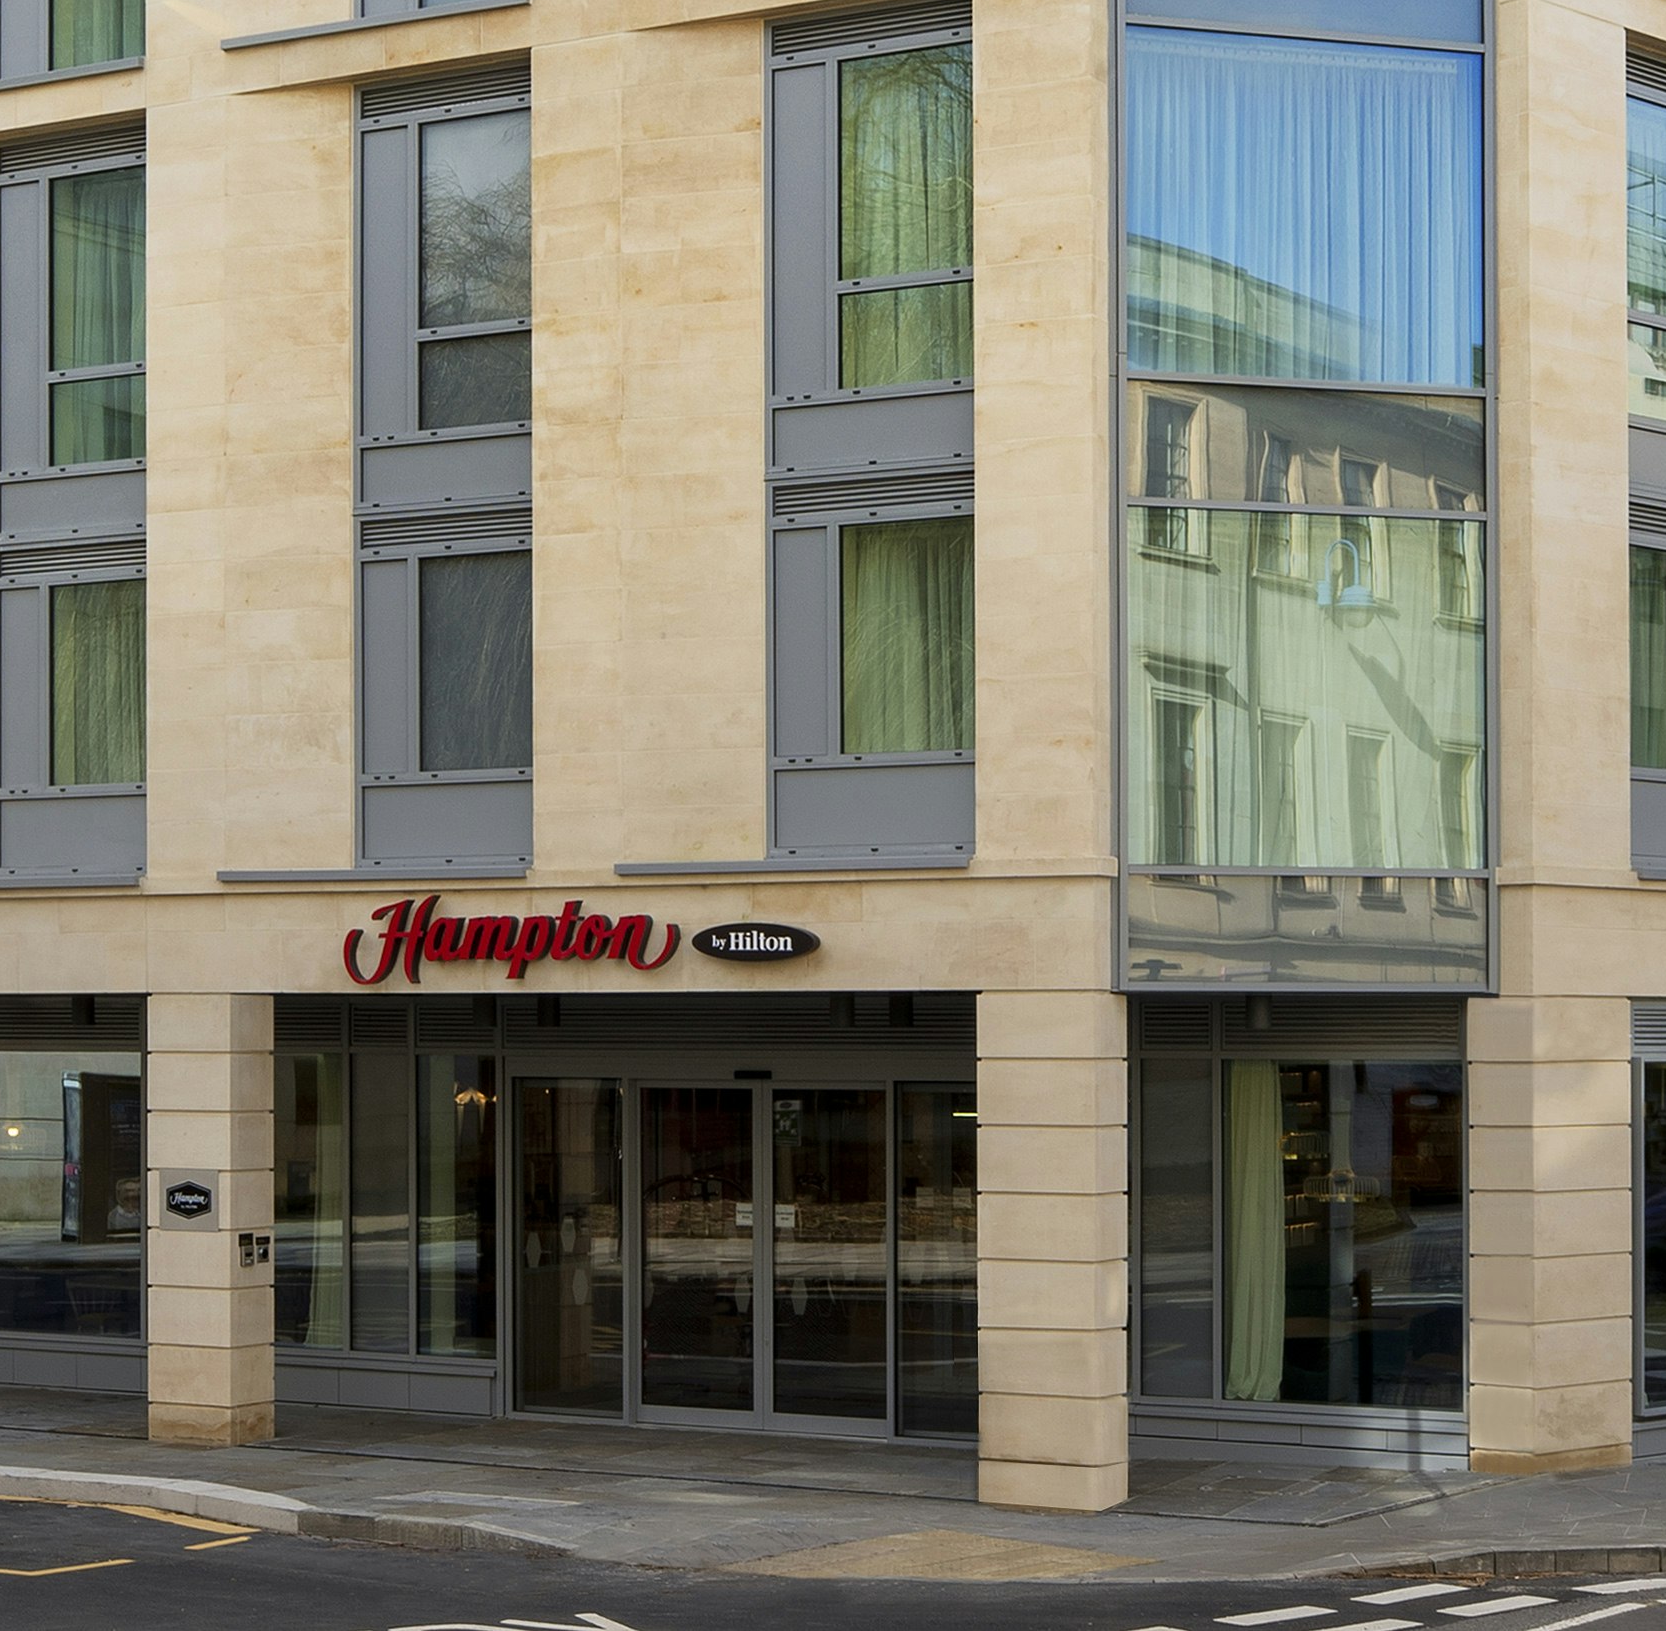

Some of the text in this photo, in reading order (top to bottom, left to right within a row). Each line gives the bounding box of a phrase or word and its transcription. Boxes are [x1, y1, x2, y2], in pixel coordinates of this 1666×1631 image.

[343, 894, 793, 985] Hampton by Hilton
